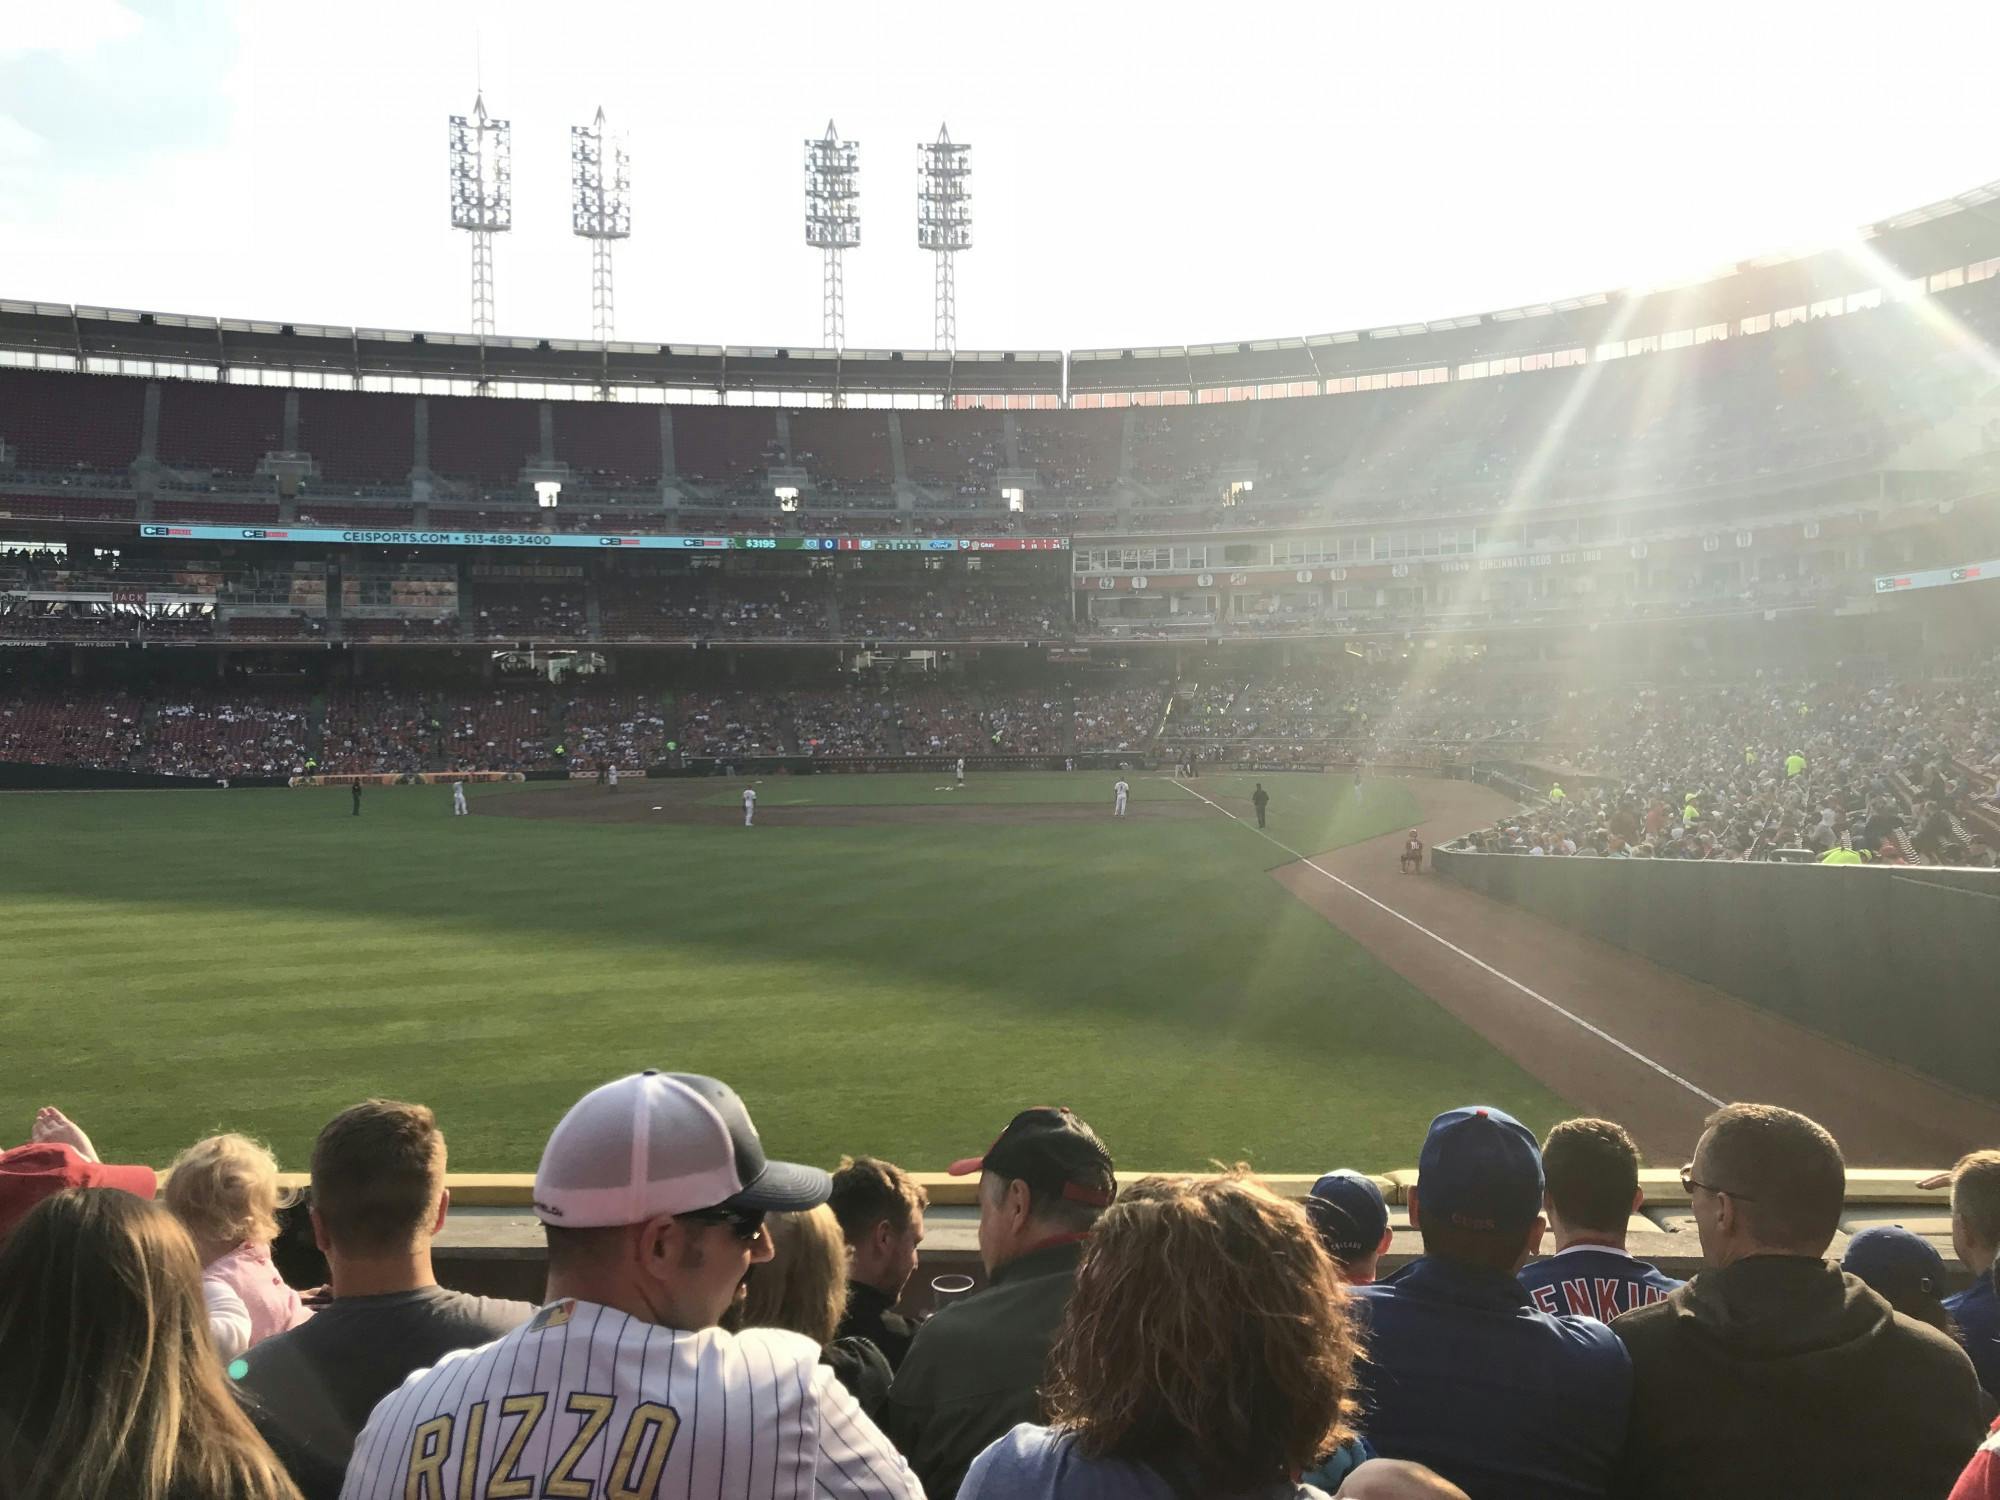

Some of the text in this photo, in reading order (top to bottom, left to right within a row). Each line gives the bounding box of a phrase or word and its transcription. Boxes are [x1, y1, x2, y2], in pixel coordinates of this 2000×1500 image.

[343, 532, 552, 546] CEISPORTS.COM 513-489-3400
[114, 593, 144, 602] JACK
[404, 1391, 680, 1500] RIZZO
